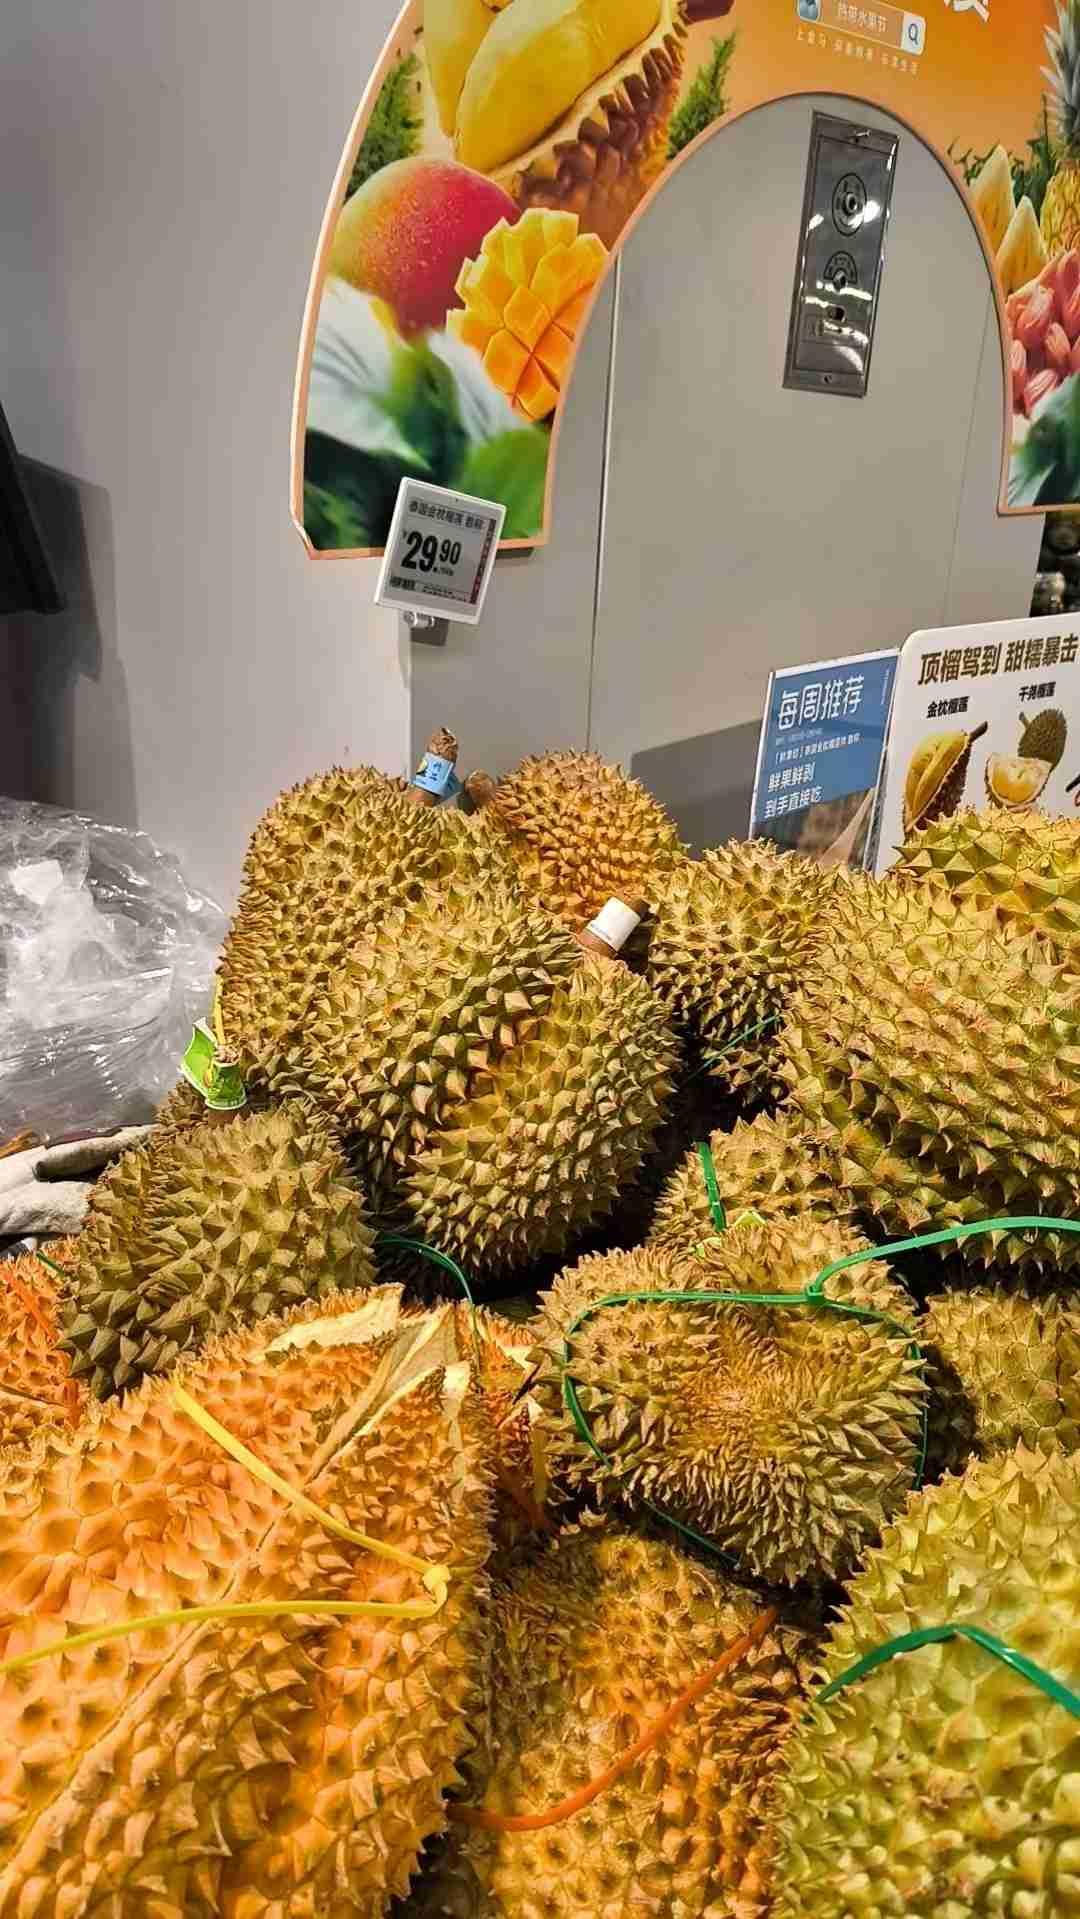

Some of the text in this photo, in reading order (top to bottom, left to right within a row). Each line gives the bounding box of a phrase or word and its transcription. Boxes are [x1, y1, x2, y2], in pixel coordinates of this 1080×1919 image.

[918, 633, 1079, 686] 顶榴驾到 甜糯暴击
[778, 674, 864, 730] 每周推荐
[926, 696, 970, 719] 金枕榴莲
[768, 762, 815, 793] 鲜果鲜剥
[764, 786, 824, 819] 到手直接吃
